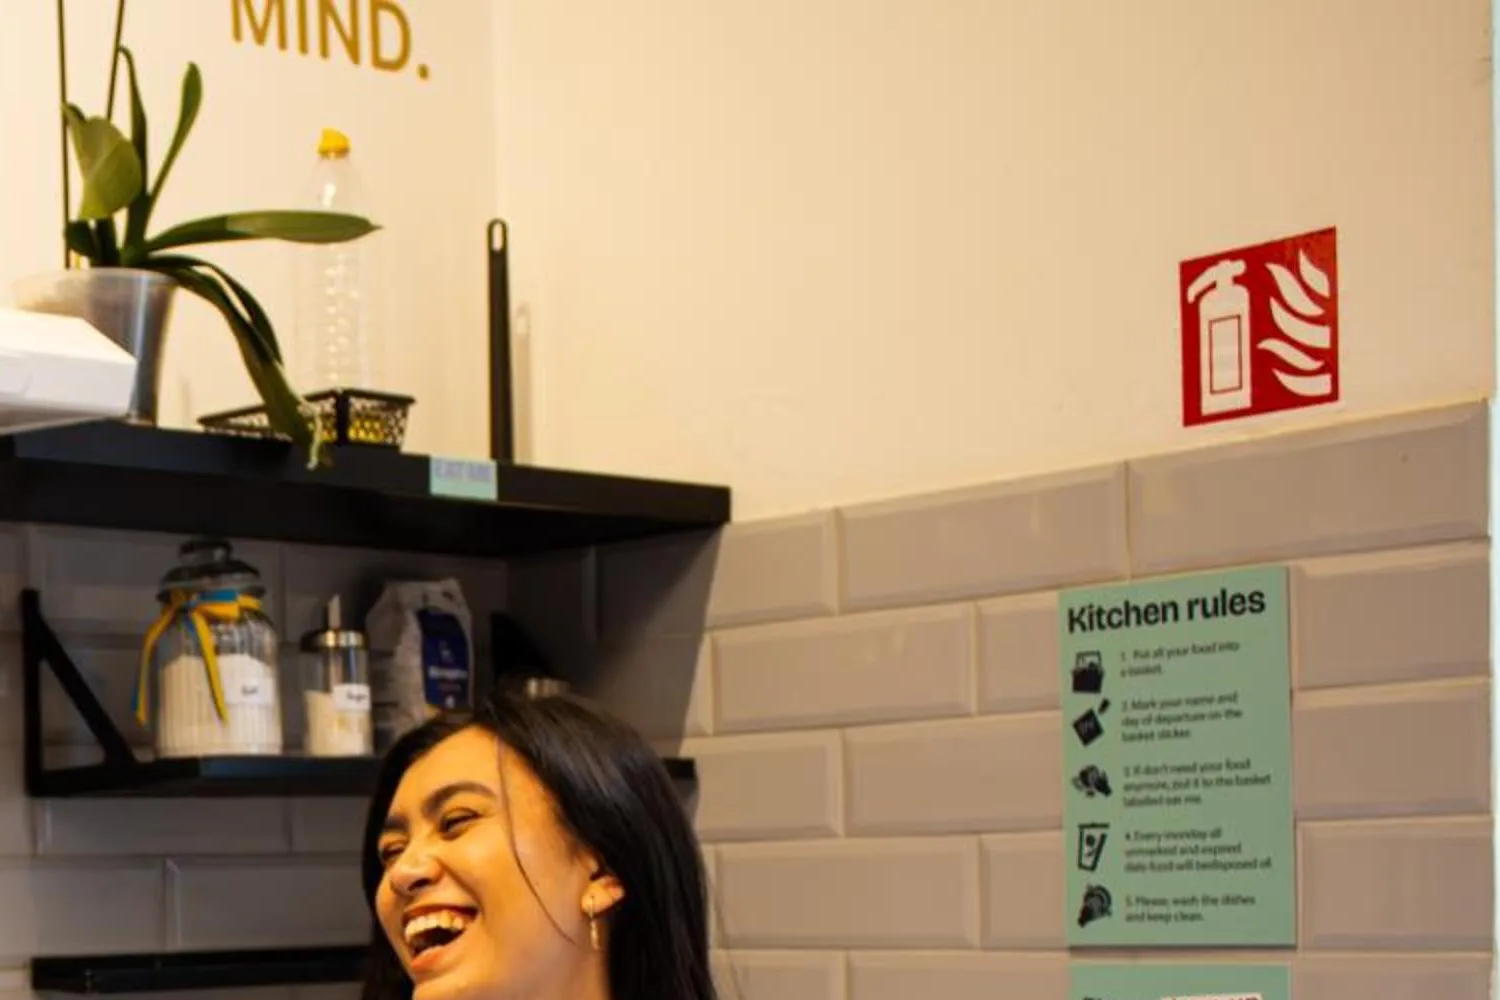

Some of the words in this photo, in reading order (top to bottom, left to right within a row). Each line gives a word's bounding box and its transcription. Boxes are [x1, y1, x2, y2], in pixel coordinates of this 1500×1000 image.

[231, 0, 429, 80] MIND.
[1067, 600, 1179, 633] Kitchen
[1187, 588, 1266, 622] rules
[1155, 712, 1206, 724] departure
